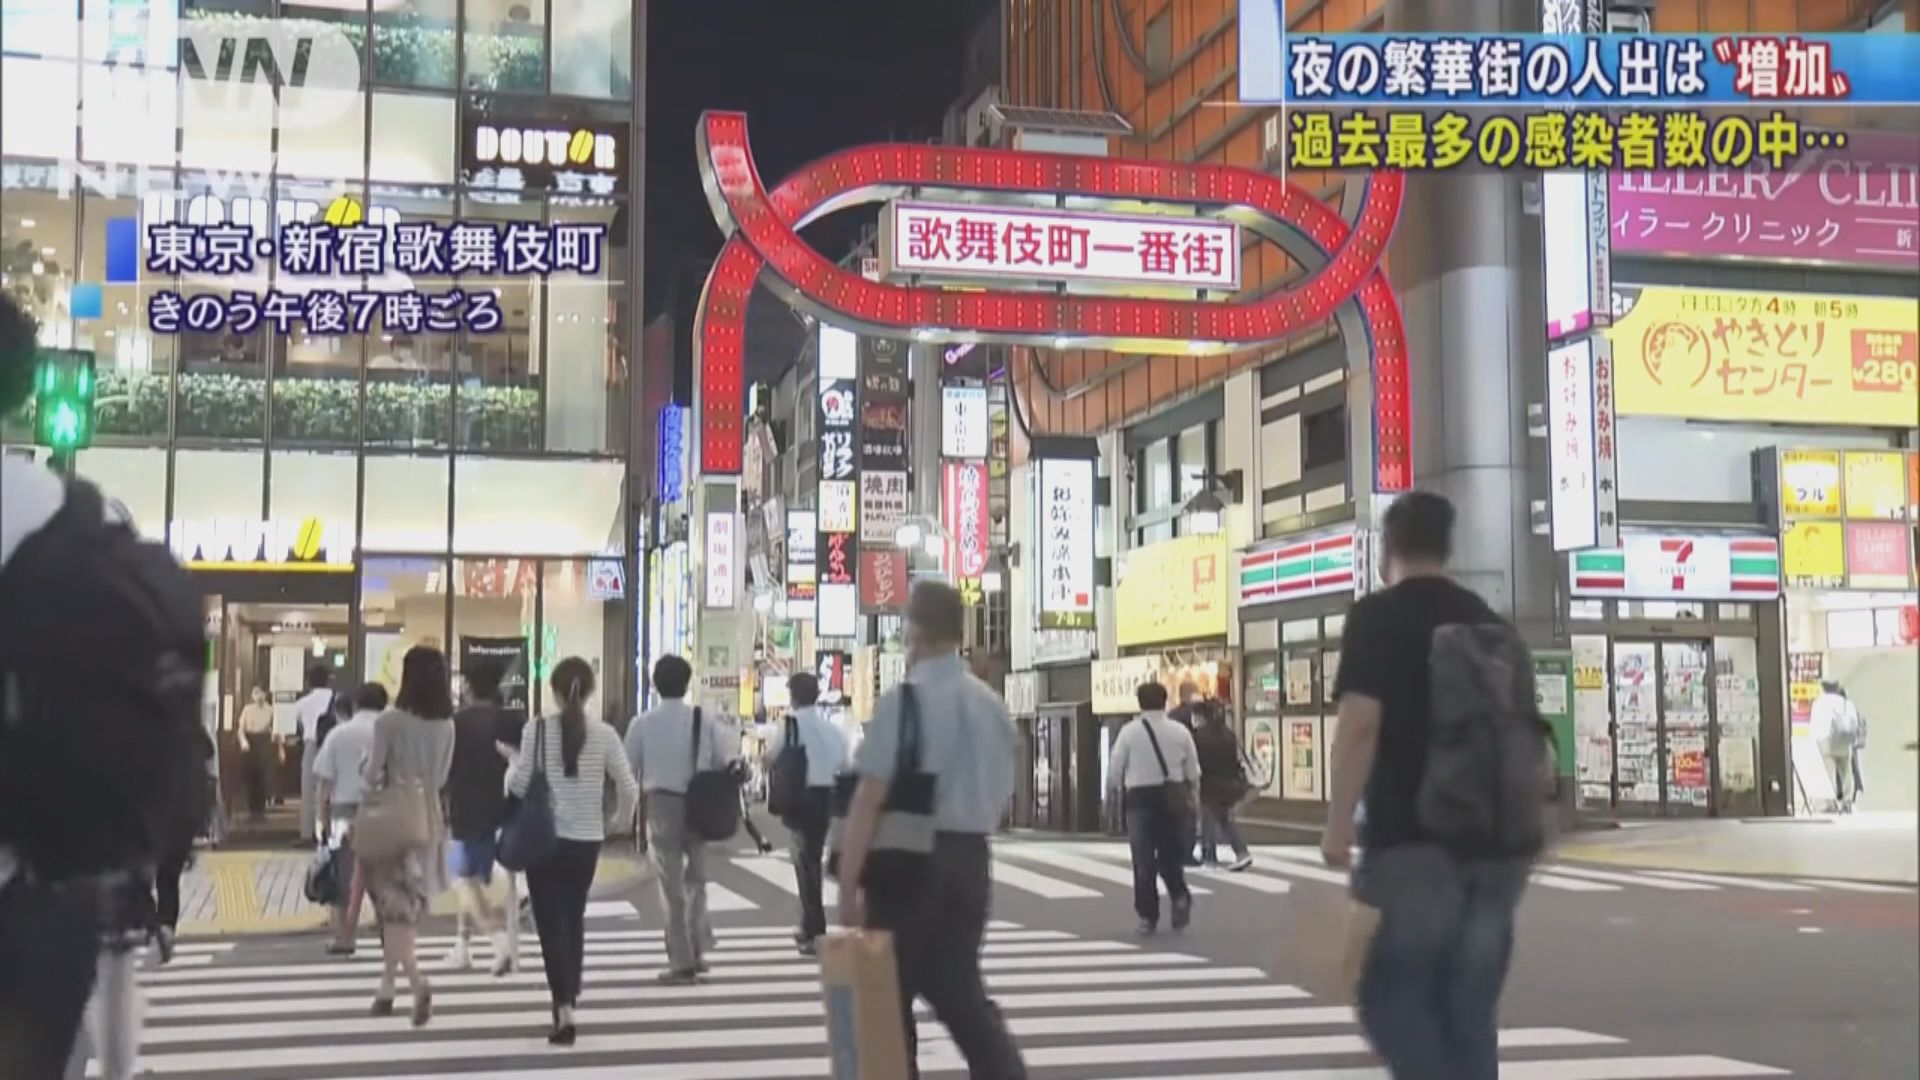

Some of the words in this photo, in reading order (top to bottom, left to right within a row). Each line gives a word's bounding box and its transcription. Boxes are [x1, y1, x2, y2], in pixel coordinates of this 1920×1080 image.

[476, 126, 616, 169] DOUTOR
[908, 215, 1225, 278] 歌舞伎町一番街
[1701, 211, 1841, 248] クリニック
[1711, 316, 1826, 358] やきとり
[1715, 358, 1834, 400] センター
[468, 644, 521, 656] Information
